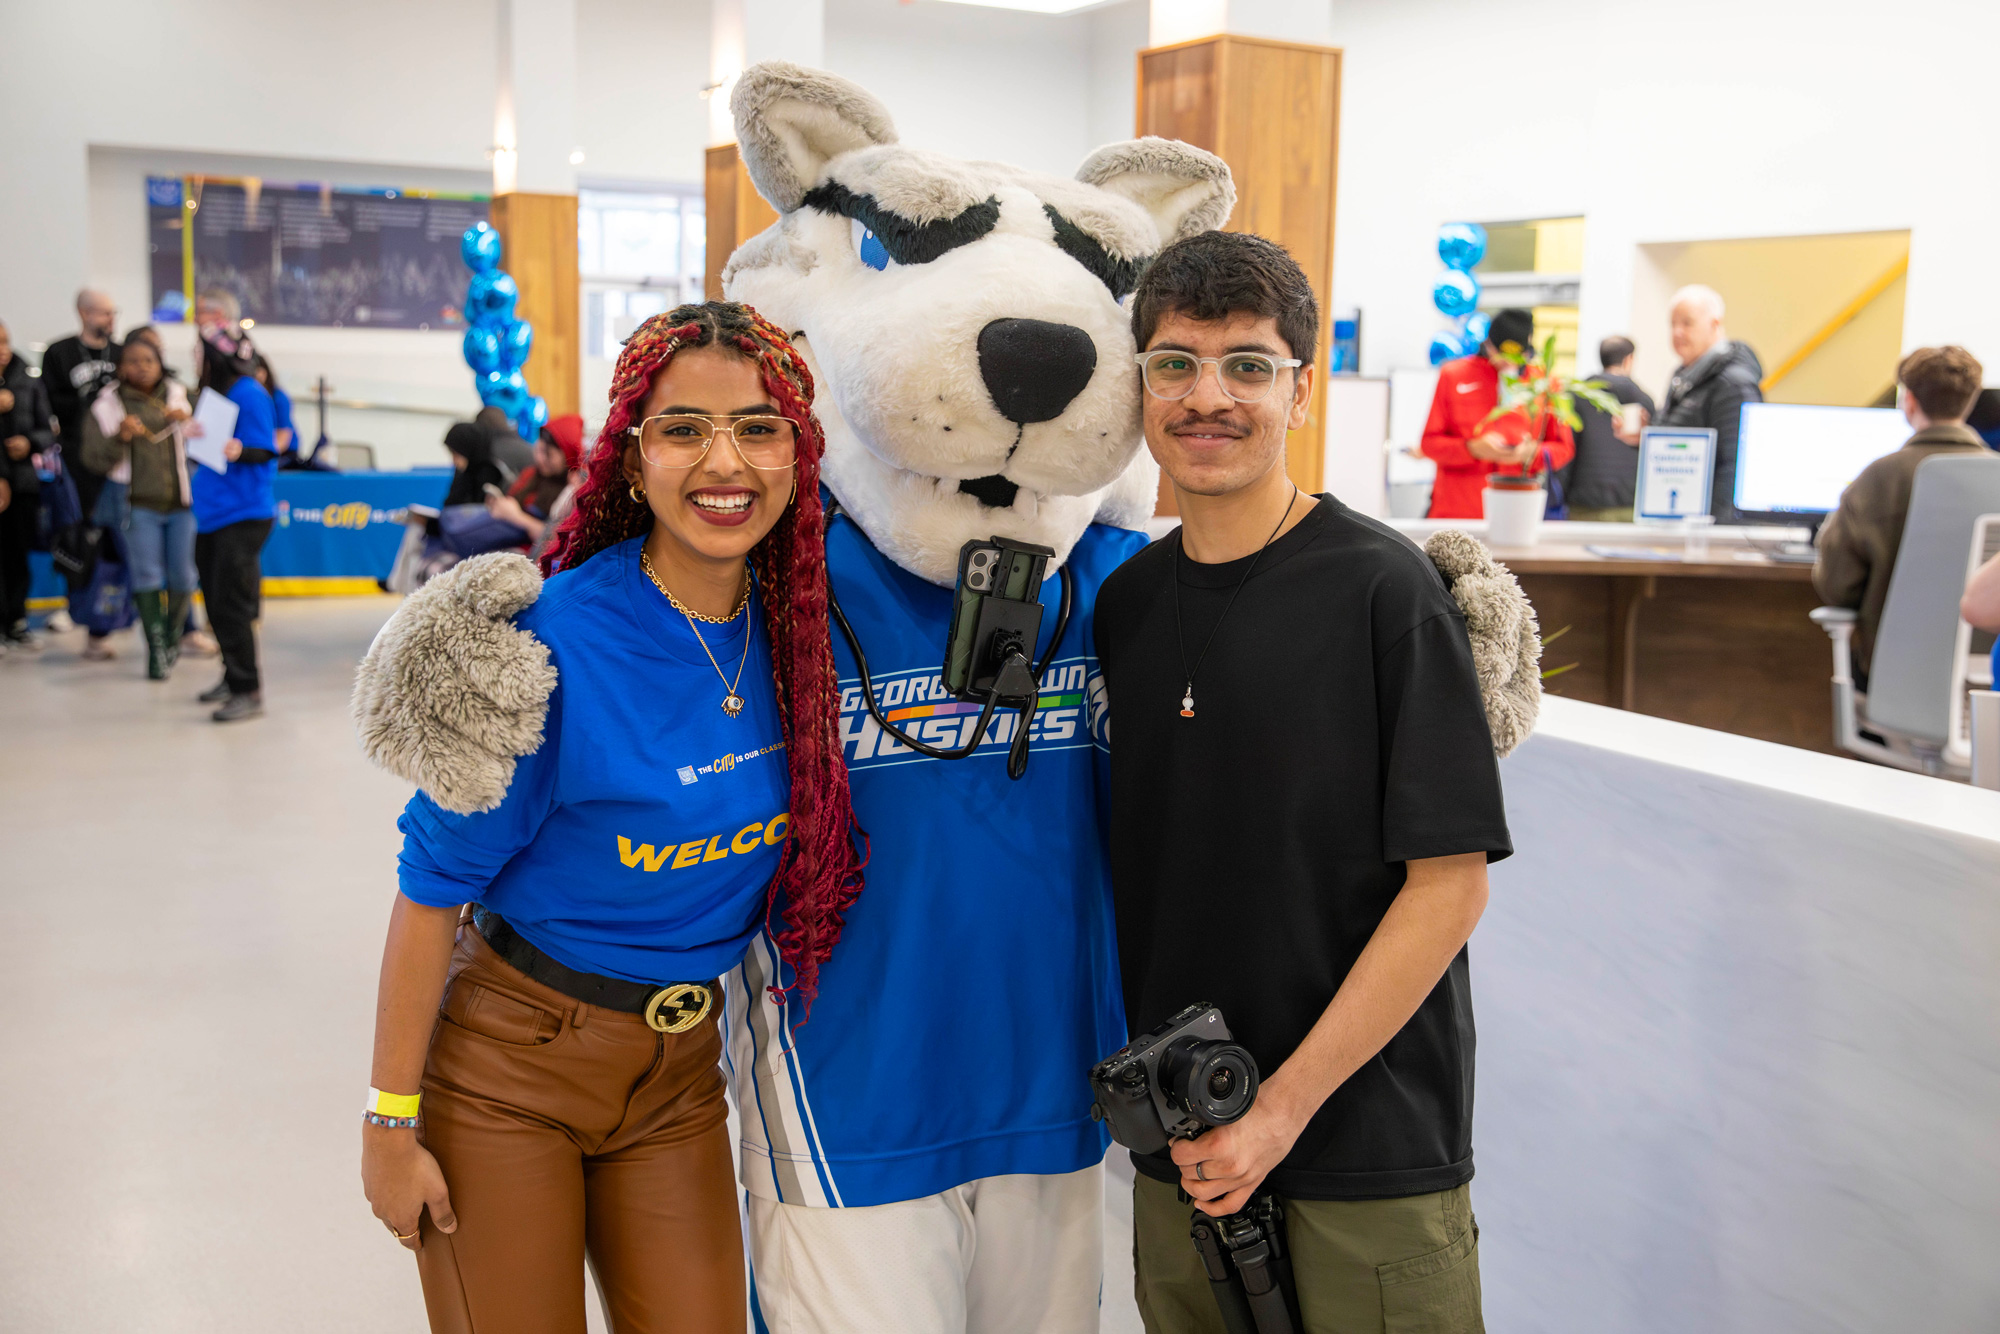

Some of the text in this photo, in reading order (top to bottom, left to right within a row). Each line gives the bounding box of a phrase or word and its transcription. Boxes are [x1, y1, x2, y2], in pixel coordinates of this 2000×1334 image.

[323, 502, 371, 529] CITY
[840, 665, 1086, 713] GEORGWN
[698, 742, 787, 775] THE CITY IS OUR CLASSR
[839, 709, 1079, 760] HUSKIES
[617, 812, 798, 872] WELCO
